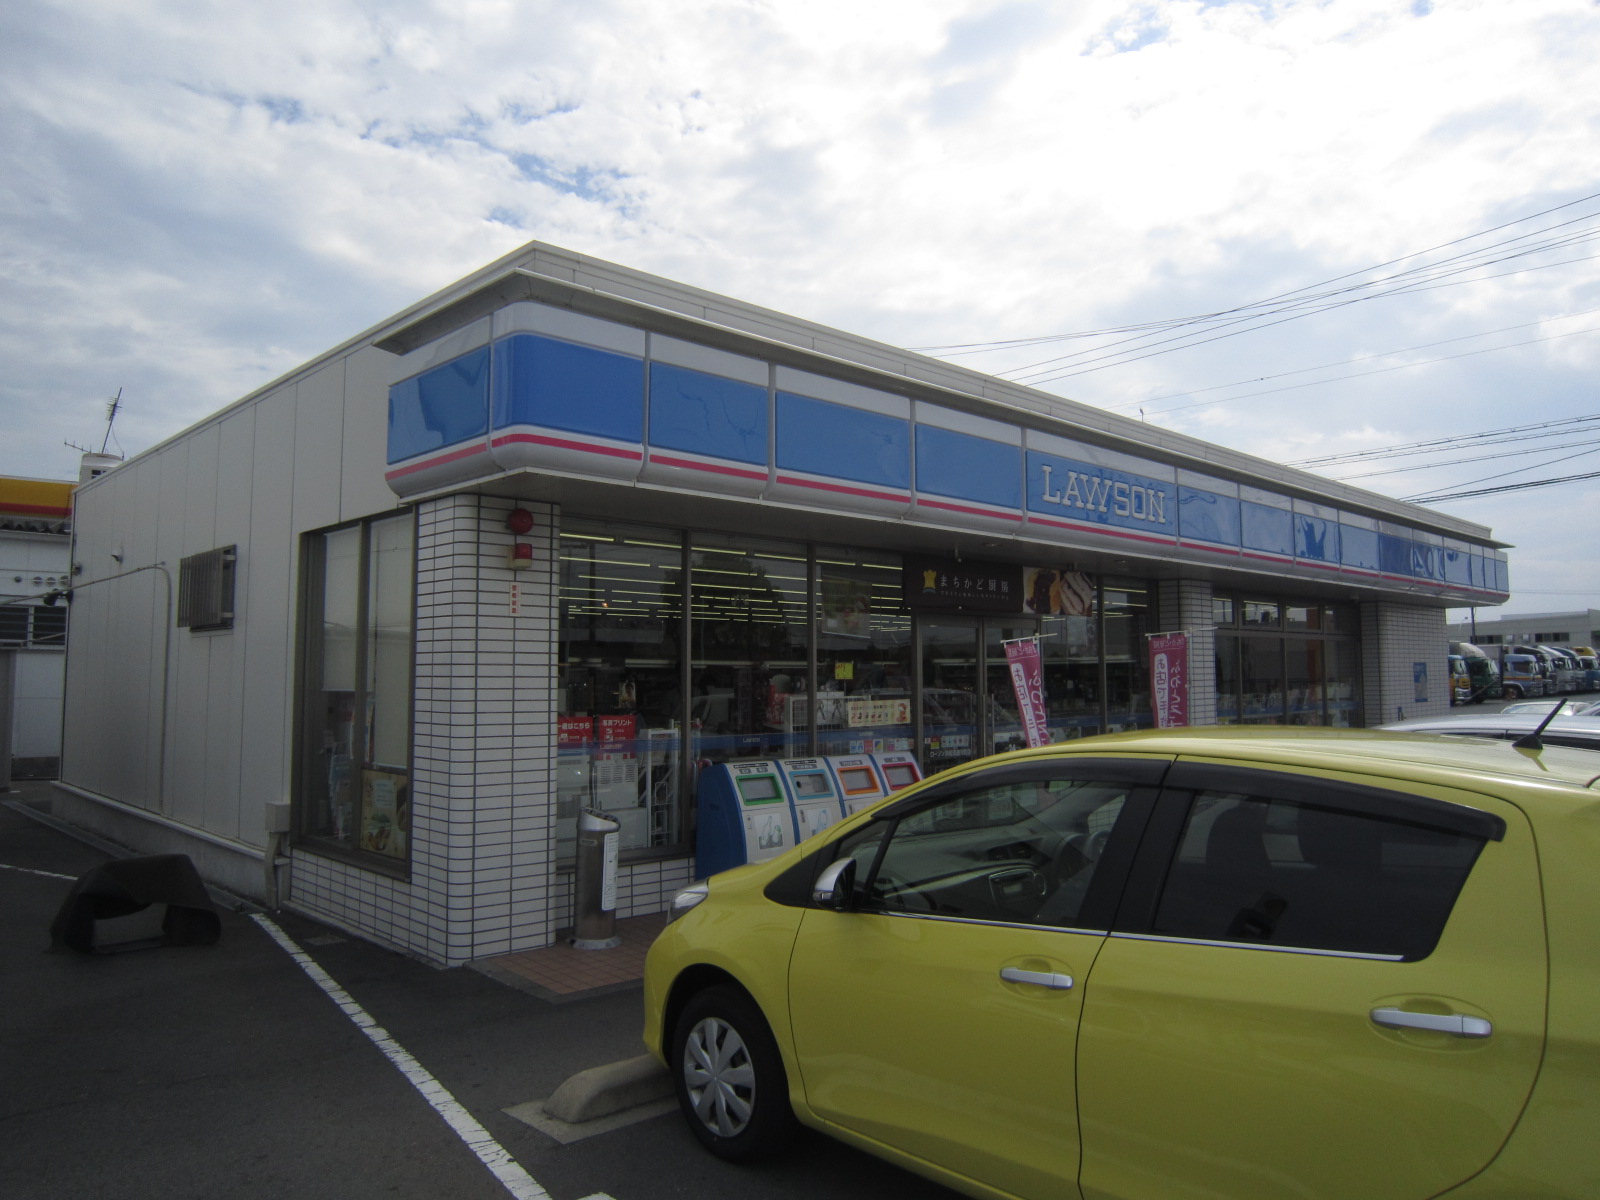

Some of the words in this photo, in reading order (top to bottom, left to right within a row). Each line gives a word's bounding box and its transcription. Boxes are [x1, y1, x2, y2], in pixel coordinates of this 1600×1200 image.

[1041, 464, 1166, 524] LAWSON
[940, 574, 1009, 593] まちかど厨房
